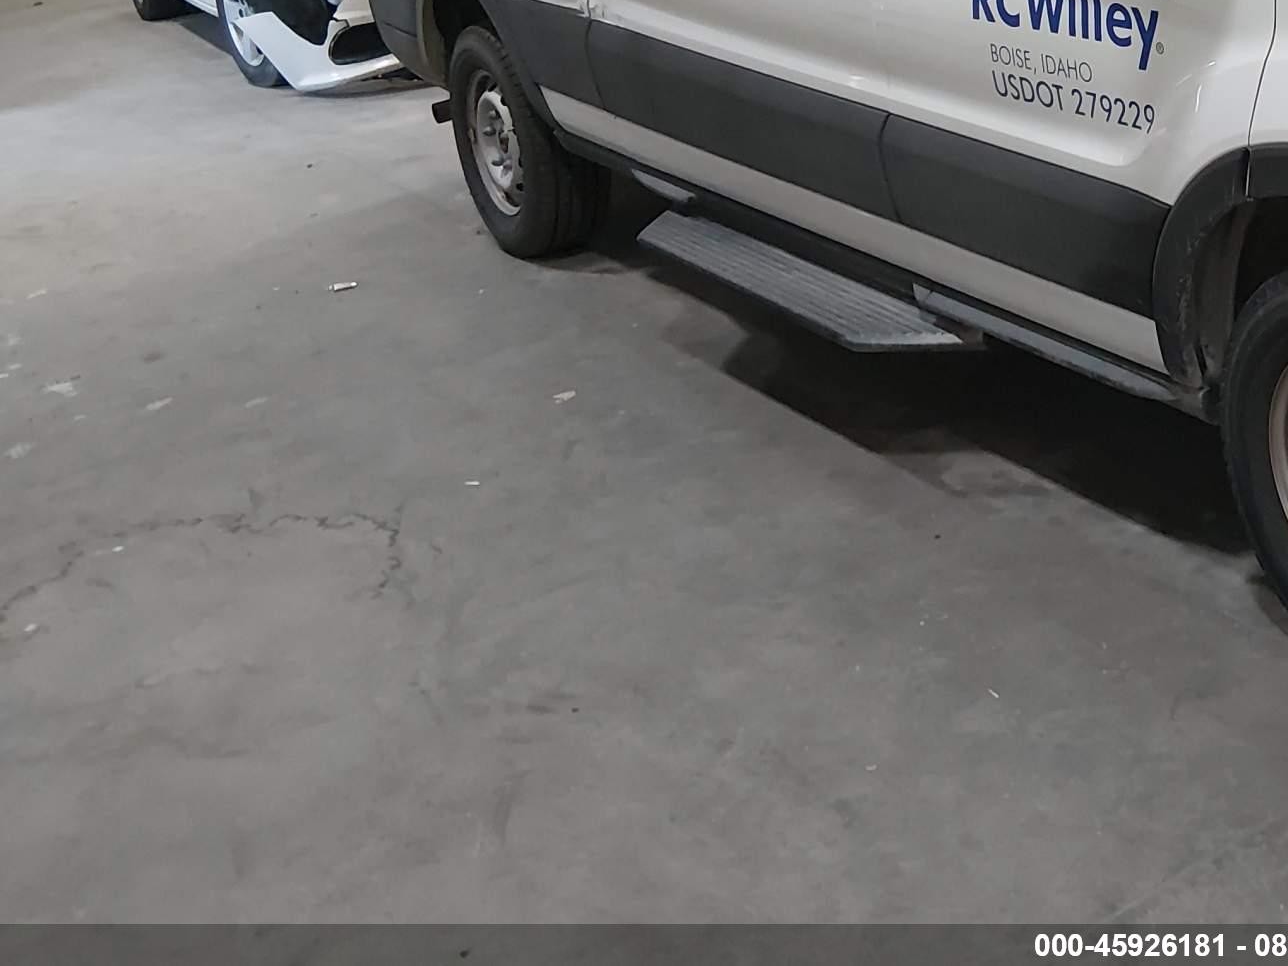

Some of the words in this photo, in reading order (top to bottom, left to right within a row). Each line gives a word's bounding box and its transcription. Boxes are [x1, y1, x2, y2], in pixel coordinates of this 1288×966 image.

[991, 43, 1037, 75] BOISE,
[1041, 54, 1093, 83] IDAHO
[992, 70, 1065, 111] USDOT
[1072, 89, 1156, 134] 279229
